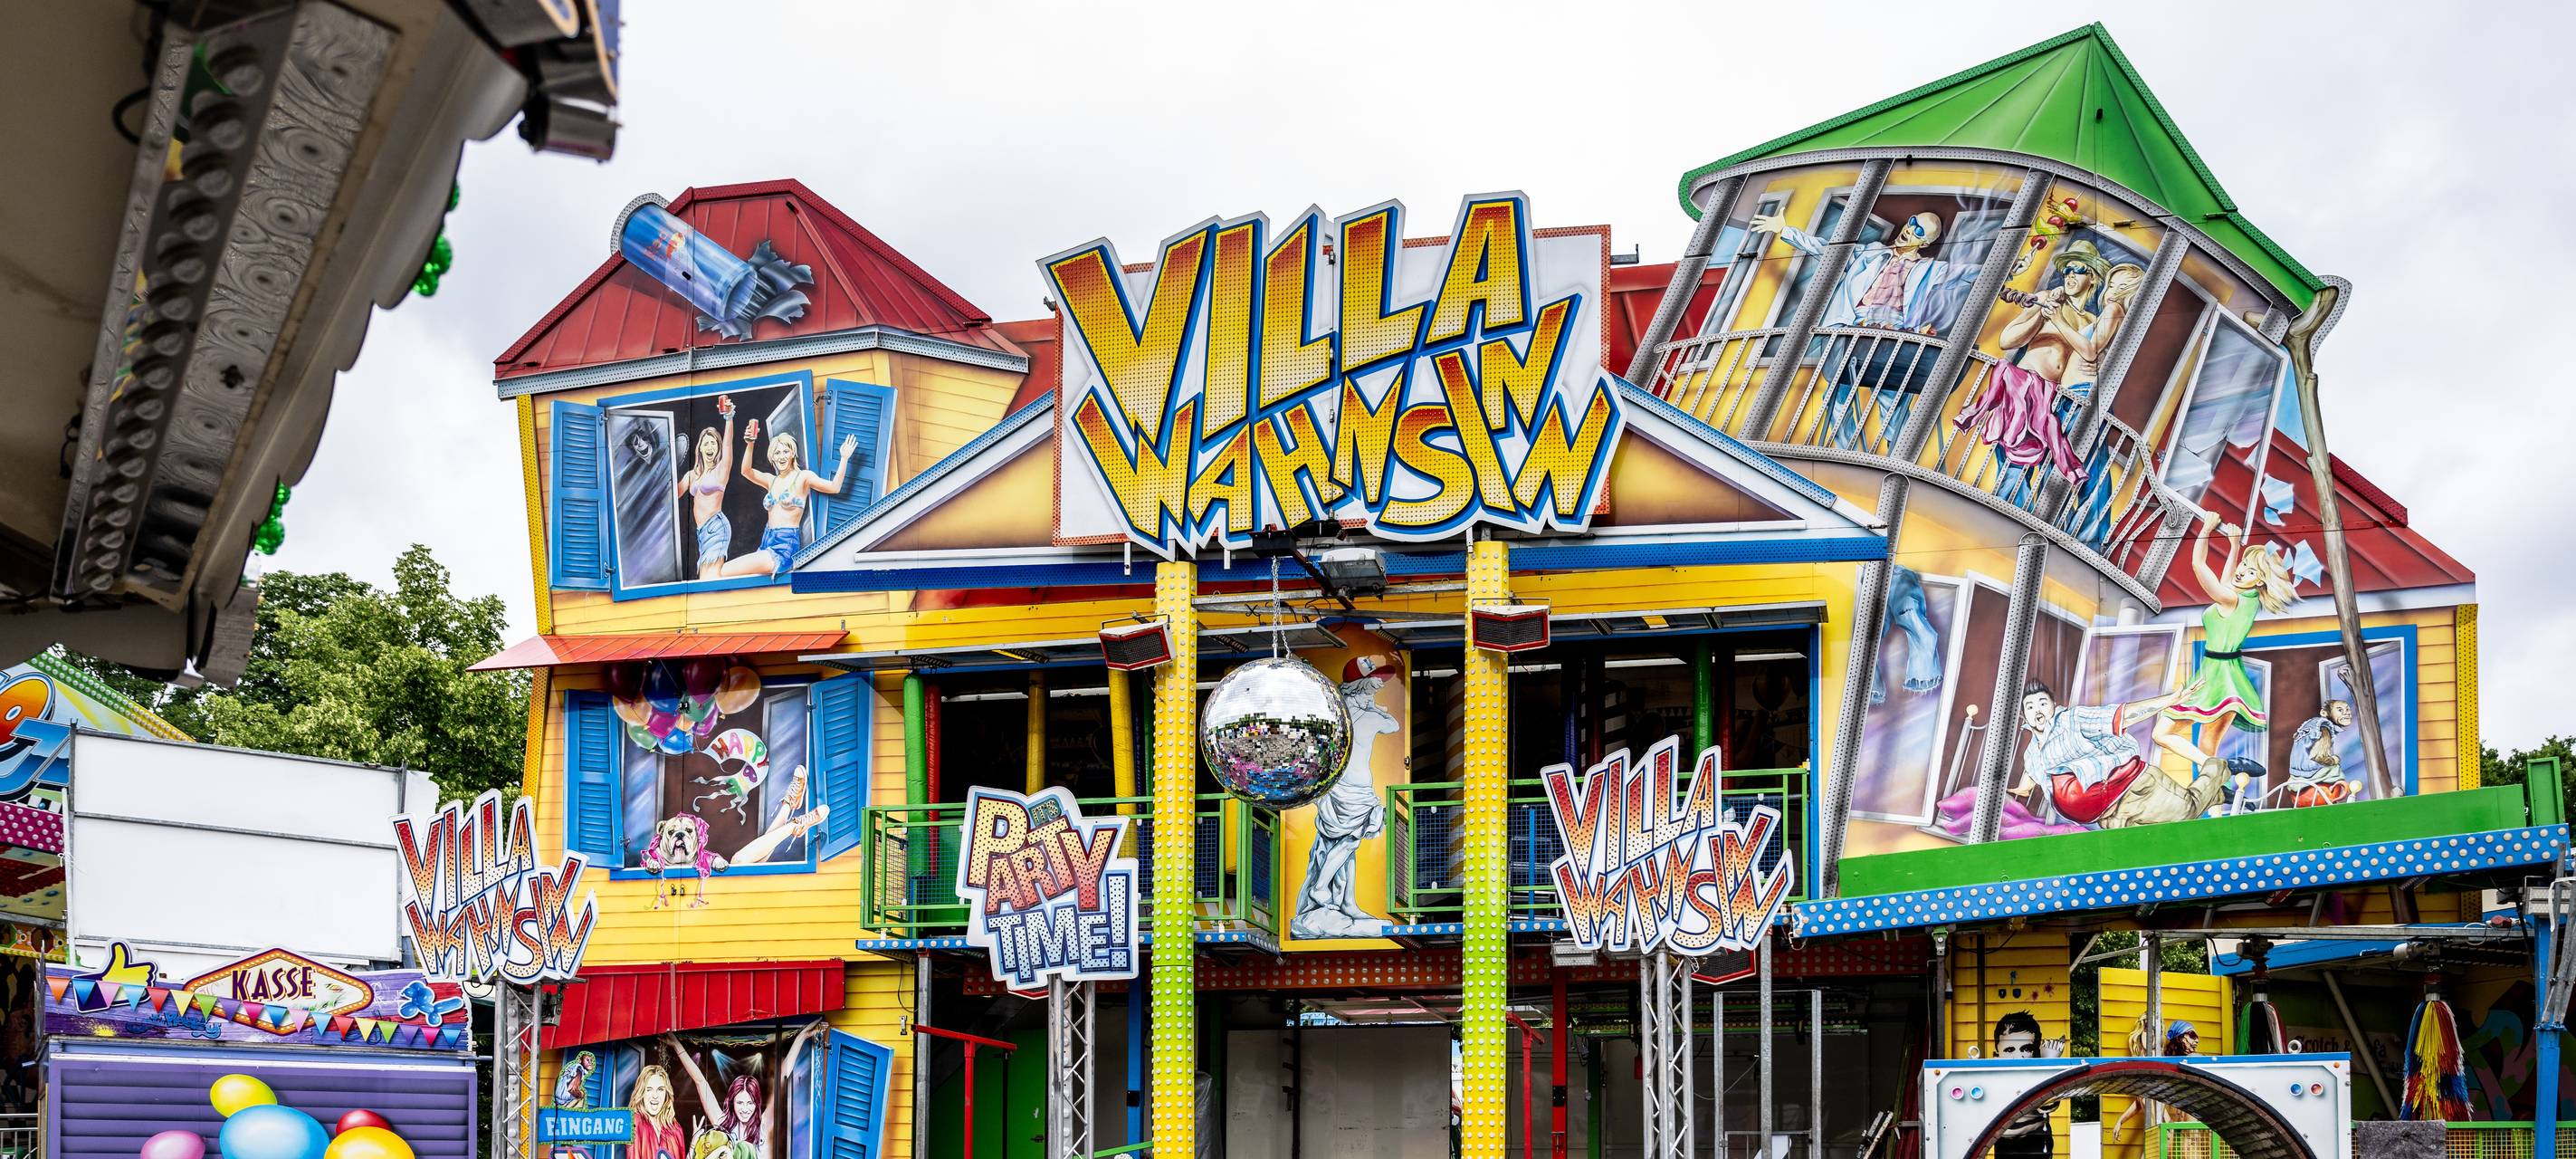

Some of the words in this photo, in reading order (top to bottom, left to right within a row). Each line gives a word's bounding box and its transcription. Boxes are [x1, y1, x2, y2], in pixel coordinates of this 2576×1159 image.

[1047, 196, 1531, 445] VILLA
[1073, 294, 1617, 538] WAHNSINN
[712, 732, 769, 769] HAPPY
[394, 797, 534, 913] VILLA
[967, 797, 1118, 915] PARTY
[1547, 747, 1715, 877] VILLA
[405, 857, 593, 979] WAHNSINN
[1556, 813, 1788, 949] WAHNSINN
[232, 966, 316, 1001] KASSE
[546, 1116, 624, 1135] EINGANG
